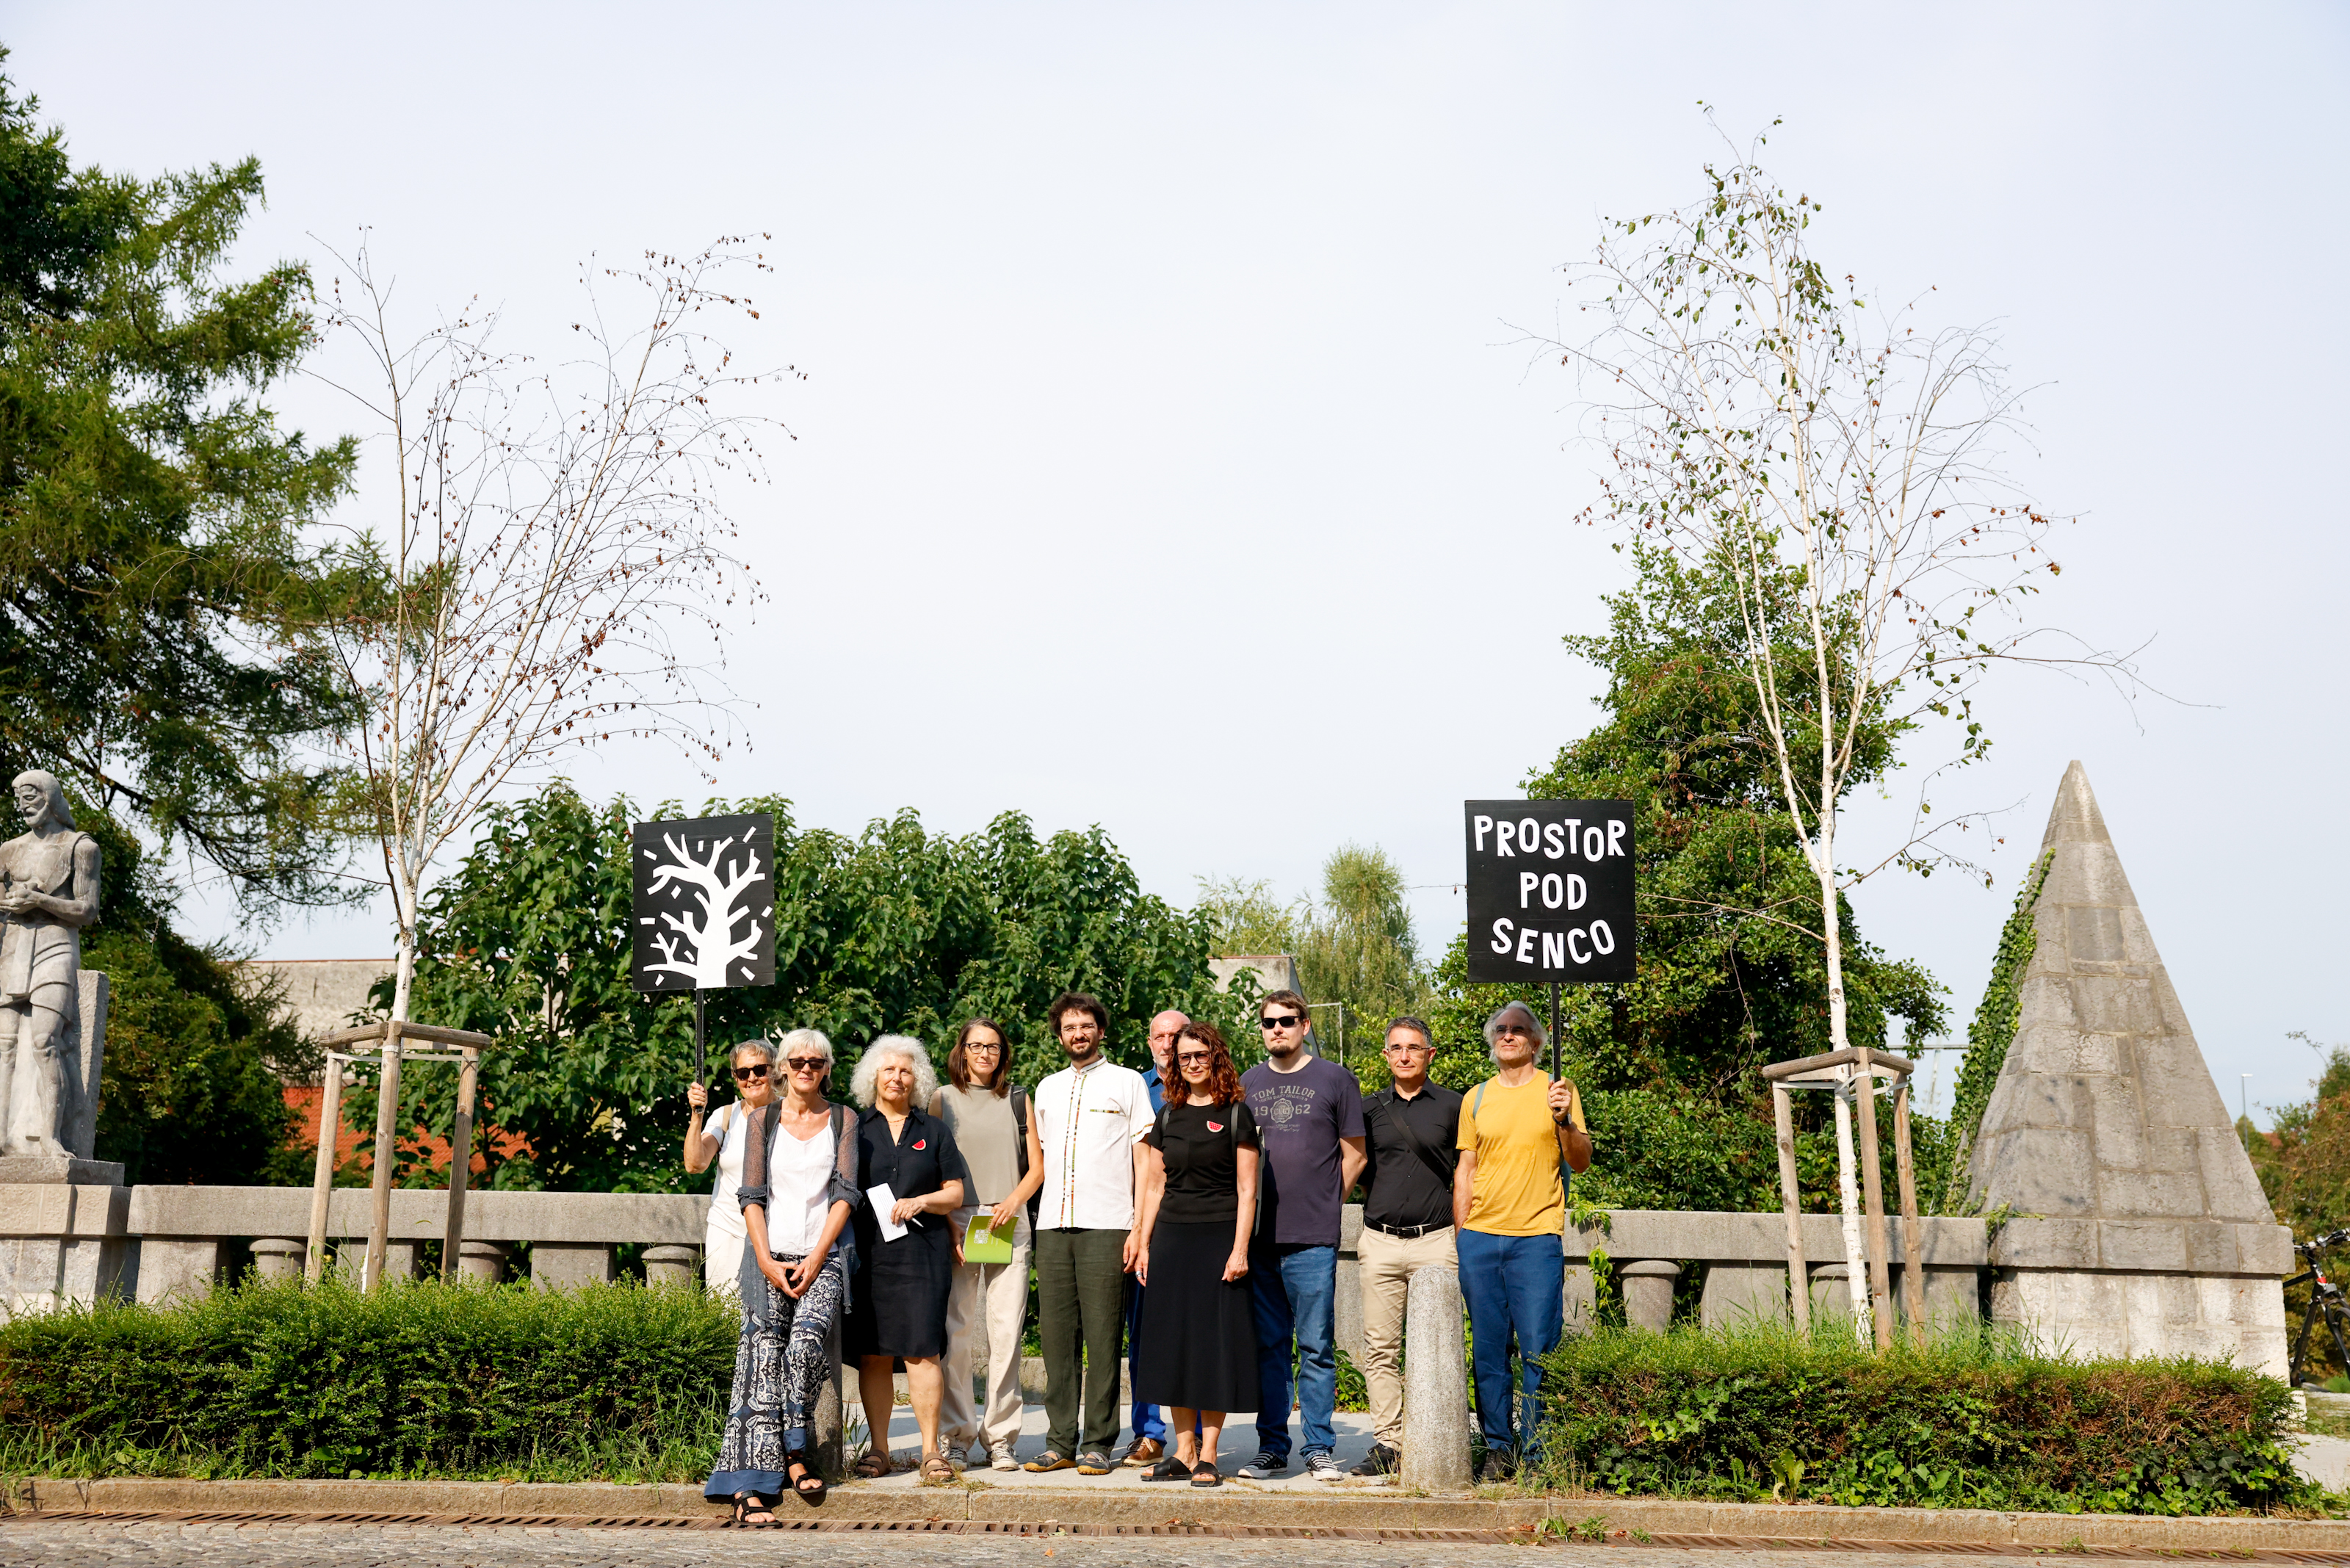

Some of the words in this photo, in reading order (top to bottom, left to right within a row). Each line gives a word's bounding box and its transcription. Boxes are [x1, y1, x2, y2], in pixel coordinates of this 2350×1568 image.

[1474, 815, 1626, 861] PROSTOR
[1520, 872, 1587, 910] POD
[1491, 918, 1615, 969] SENCO
[1251, 1088, 1276, 1102] TOM
[1279, 1085, 1315, 1099] TAILOR
[1254, 1106, 1268, 1116] 19
[1295, 1104, 1311, 1115] 62
